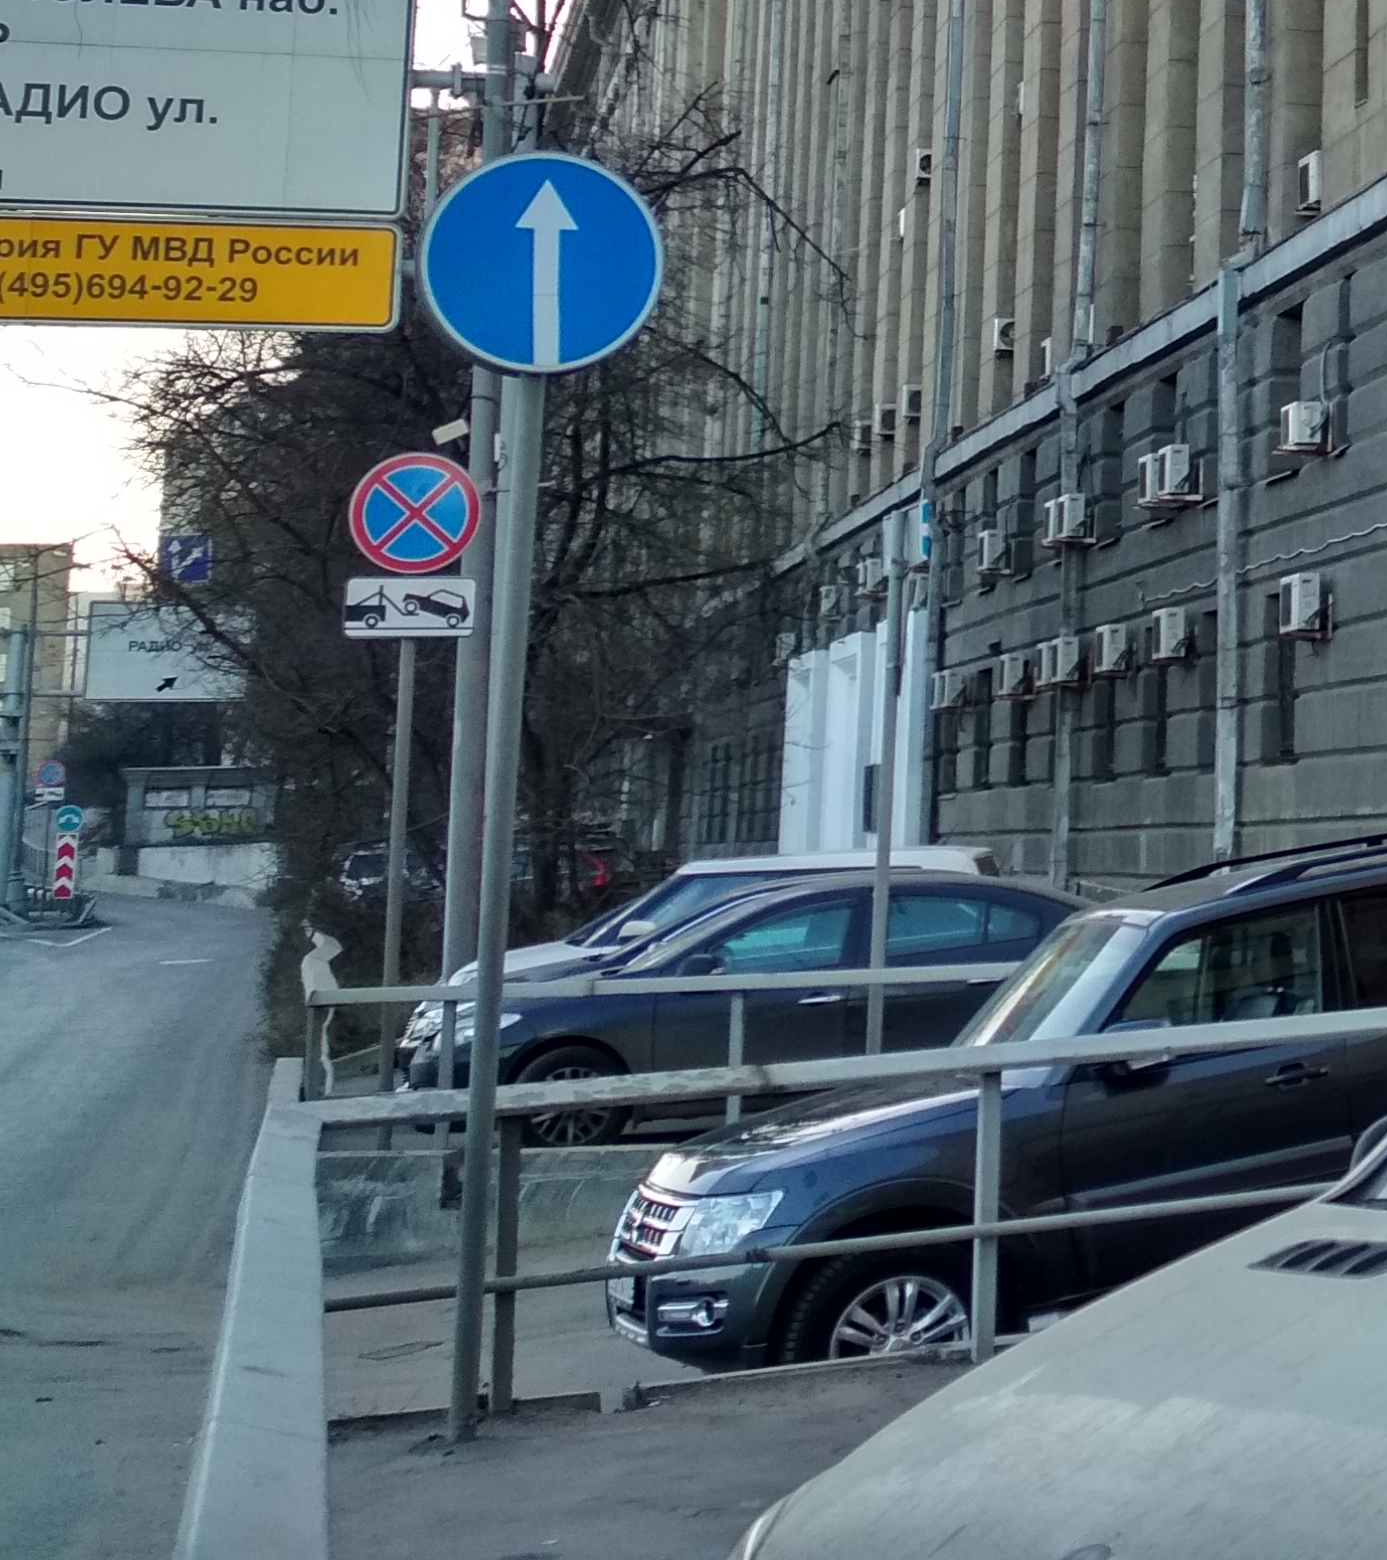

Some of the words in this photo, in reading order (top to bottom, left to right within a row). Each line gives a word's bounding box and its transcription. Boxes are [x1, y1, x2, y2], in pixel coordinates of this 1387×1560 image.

[146, 95, 218, 132] ул.
[75, 234, 120, 260] ГУ
[131, 236, 215, 268] МВД
[228, 238, 360, 267] России
[128, 640, 183, 653] РАДИО
